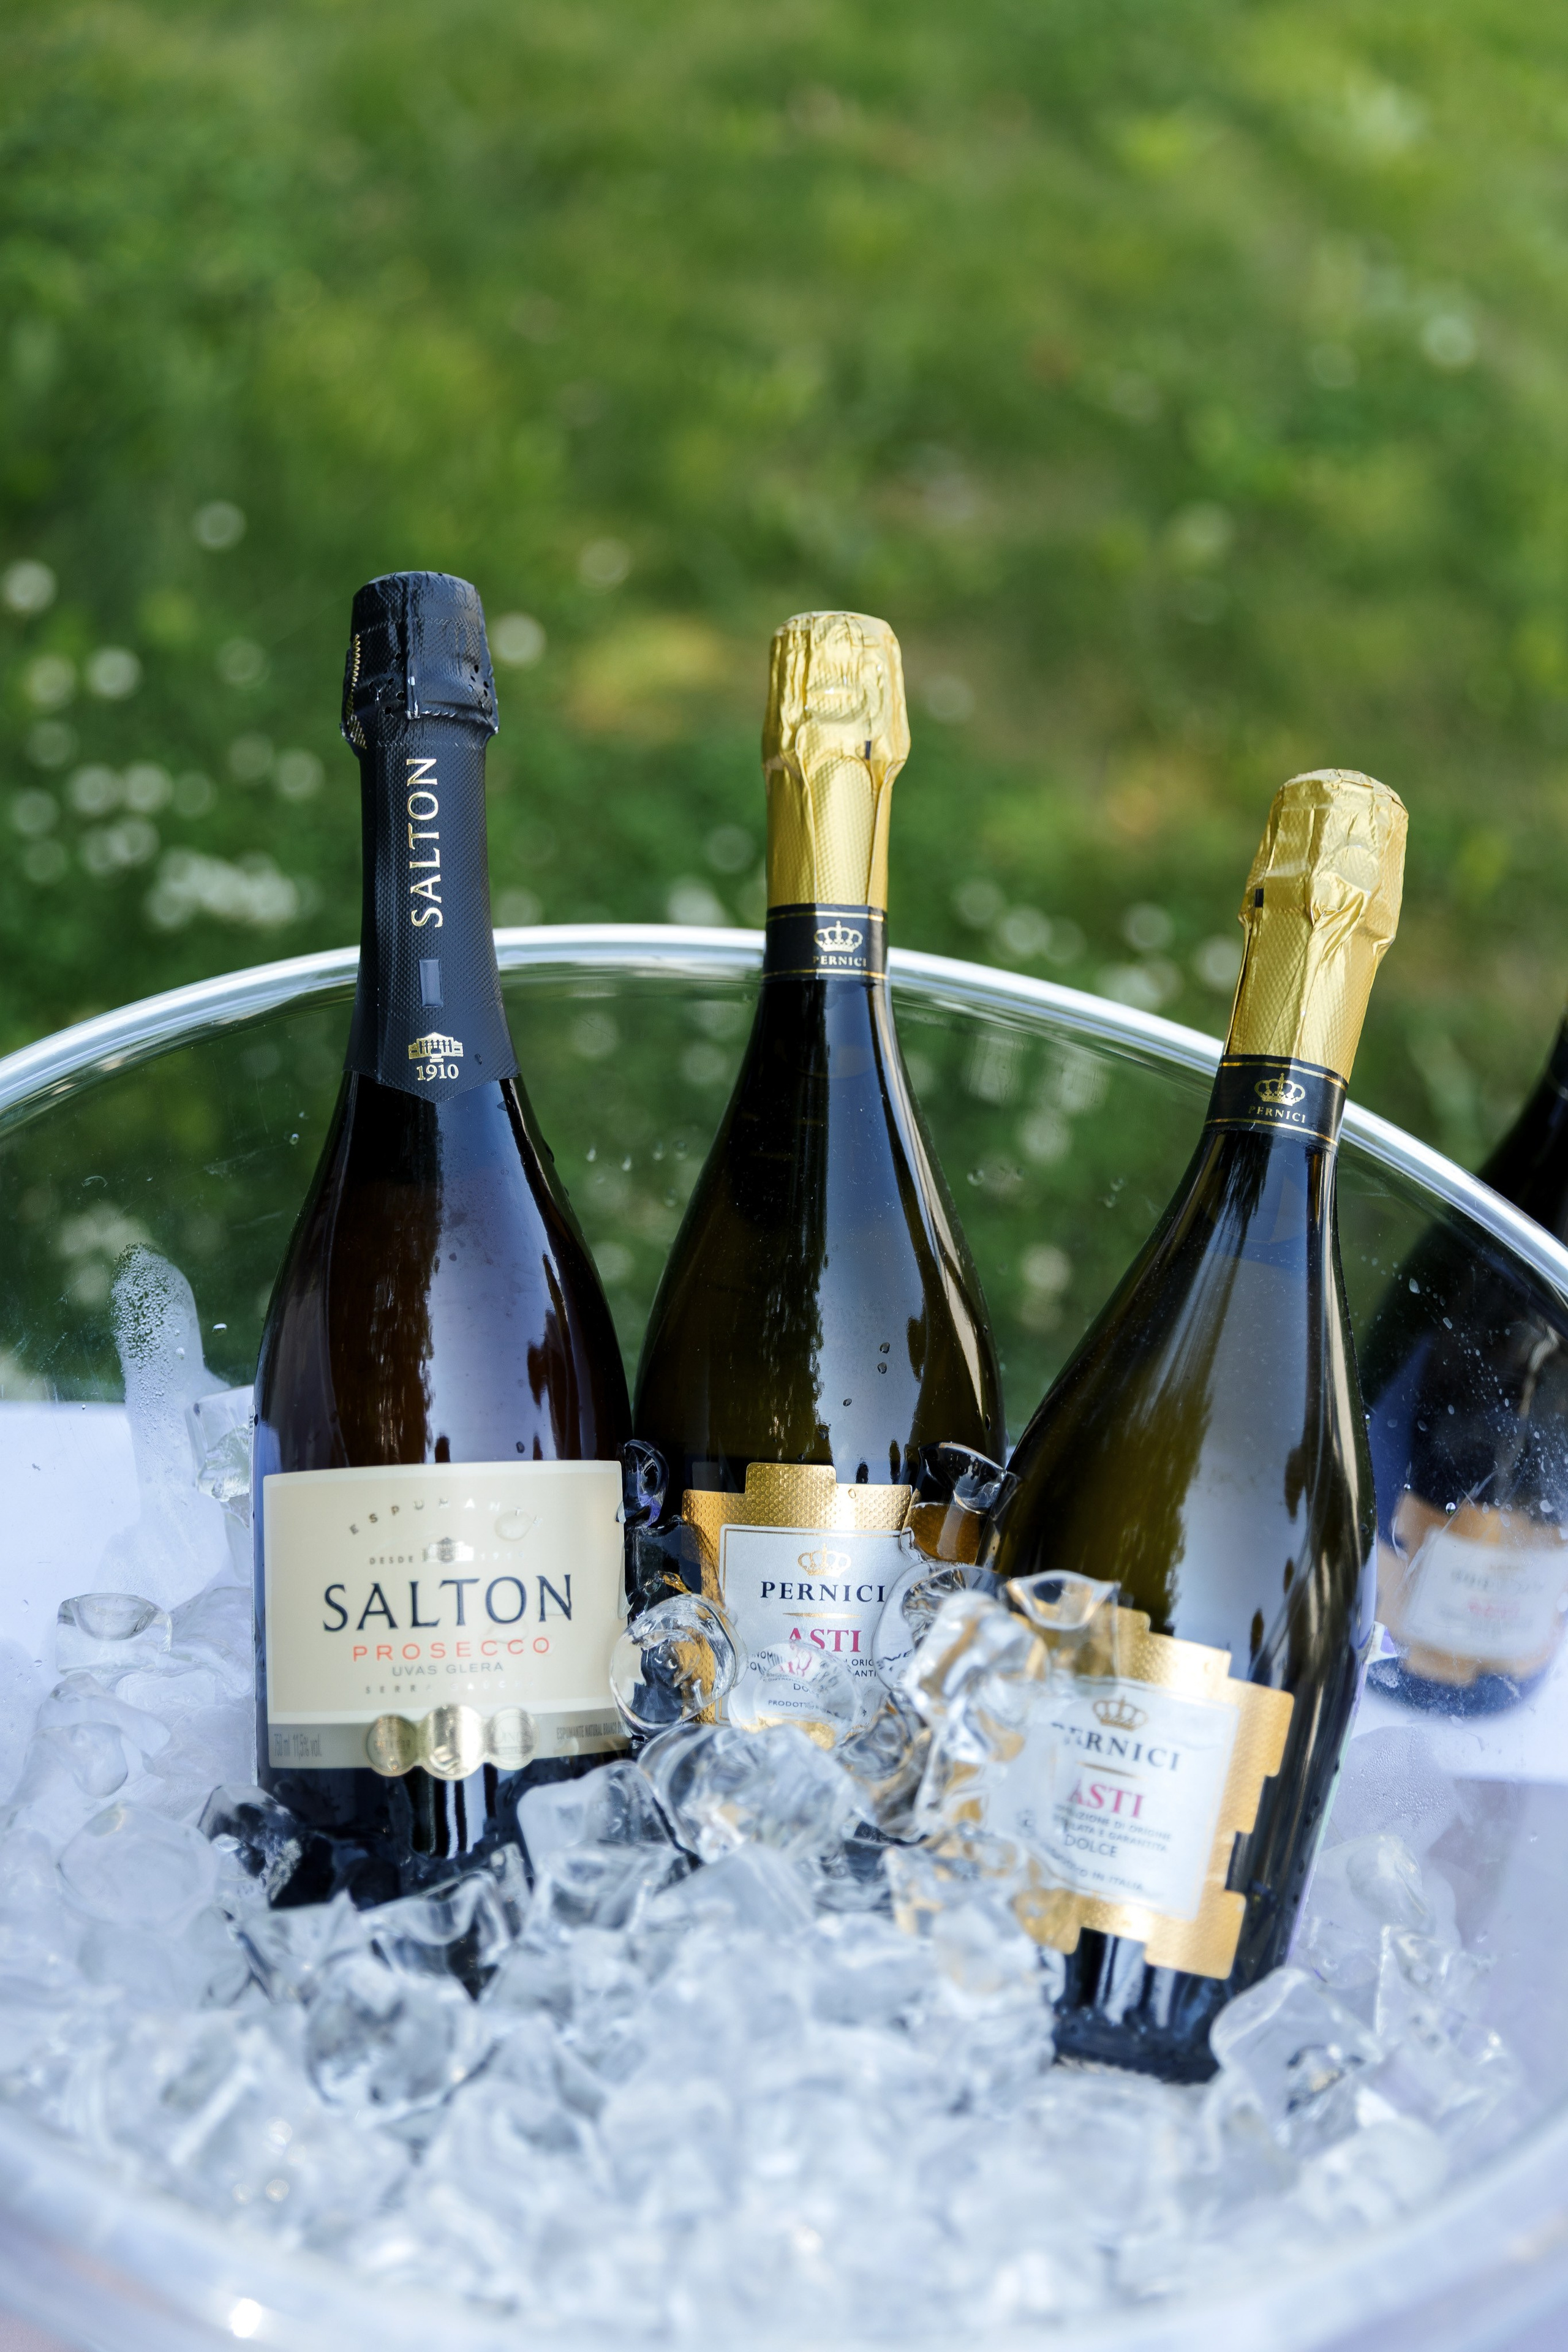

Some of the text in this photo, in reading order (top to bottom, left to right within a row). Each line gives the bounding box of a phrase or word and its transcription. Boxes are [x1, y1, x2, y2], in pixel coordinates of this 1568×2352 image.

[406, 758, 443, 928] SALTON
[813, 956, 867, 967] PERNICI
[417, 1064, 459, 1082] 1910
[1248, 1106, 1306, 1124] PERNICI
[369, 1555, 414, 1565] DESDE
[760, 1580, 885, 1603] PERNICI
[323, 1574, 573, 1632] SALTON
[353, 1637, 549, 1662] PROSECCO
[788, 1627, 862, 1653] ASTI
[392, 1662, 503, 1676] UVAS GLERA
[1108, 1831, 1168, 1852] GARANTITA
[1129, 1825, 1172, 1843] ORIGINE
[1064, 1833, 1118, 1858] DOLCE
[1092, 1871, 1144, 1891] IN ITALIA
